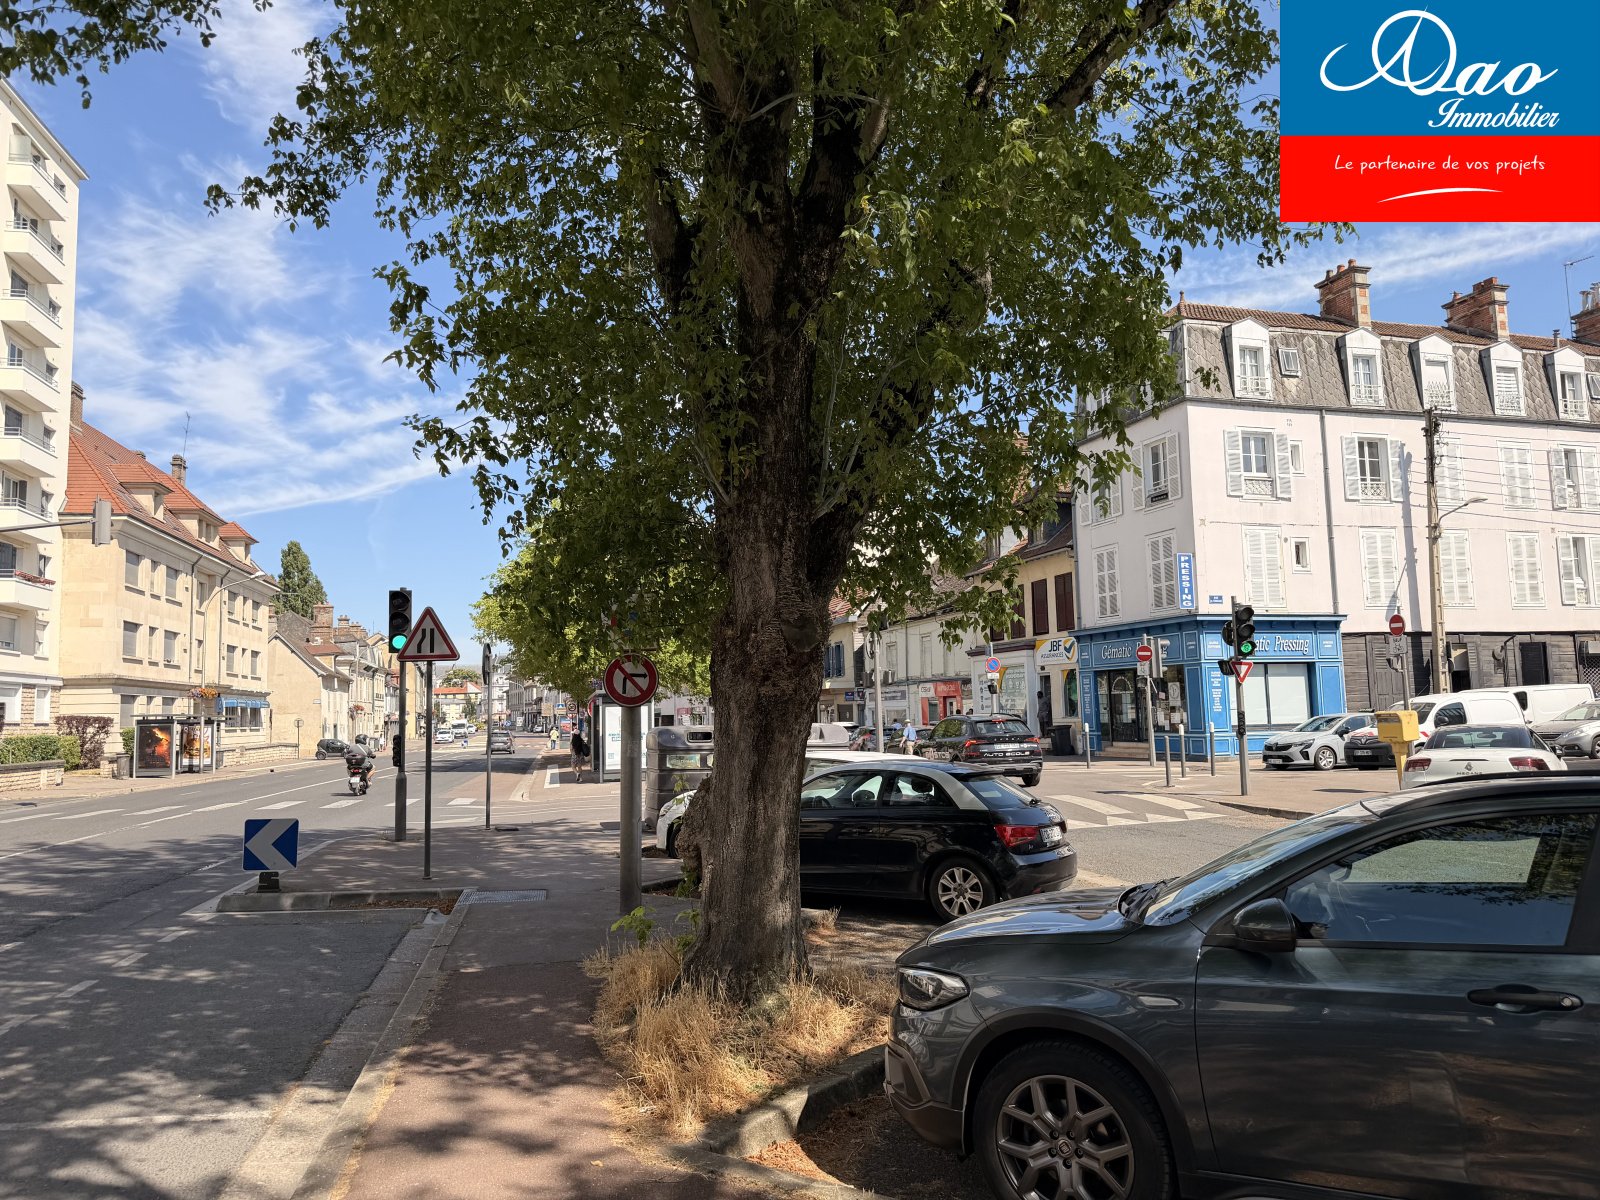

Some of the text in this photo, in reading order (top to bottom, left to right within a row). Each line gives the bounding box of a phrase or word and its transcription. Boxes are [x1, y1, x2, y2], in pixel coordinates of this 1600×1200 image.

[1181, 555, 1192, 607] PRESSING
[1049, 640, 1063, 652] JBF
[1101, 642, 1132, 660] Gématic
[1274, 635, 1310, 654] Pressing
